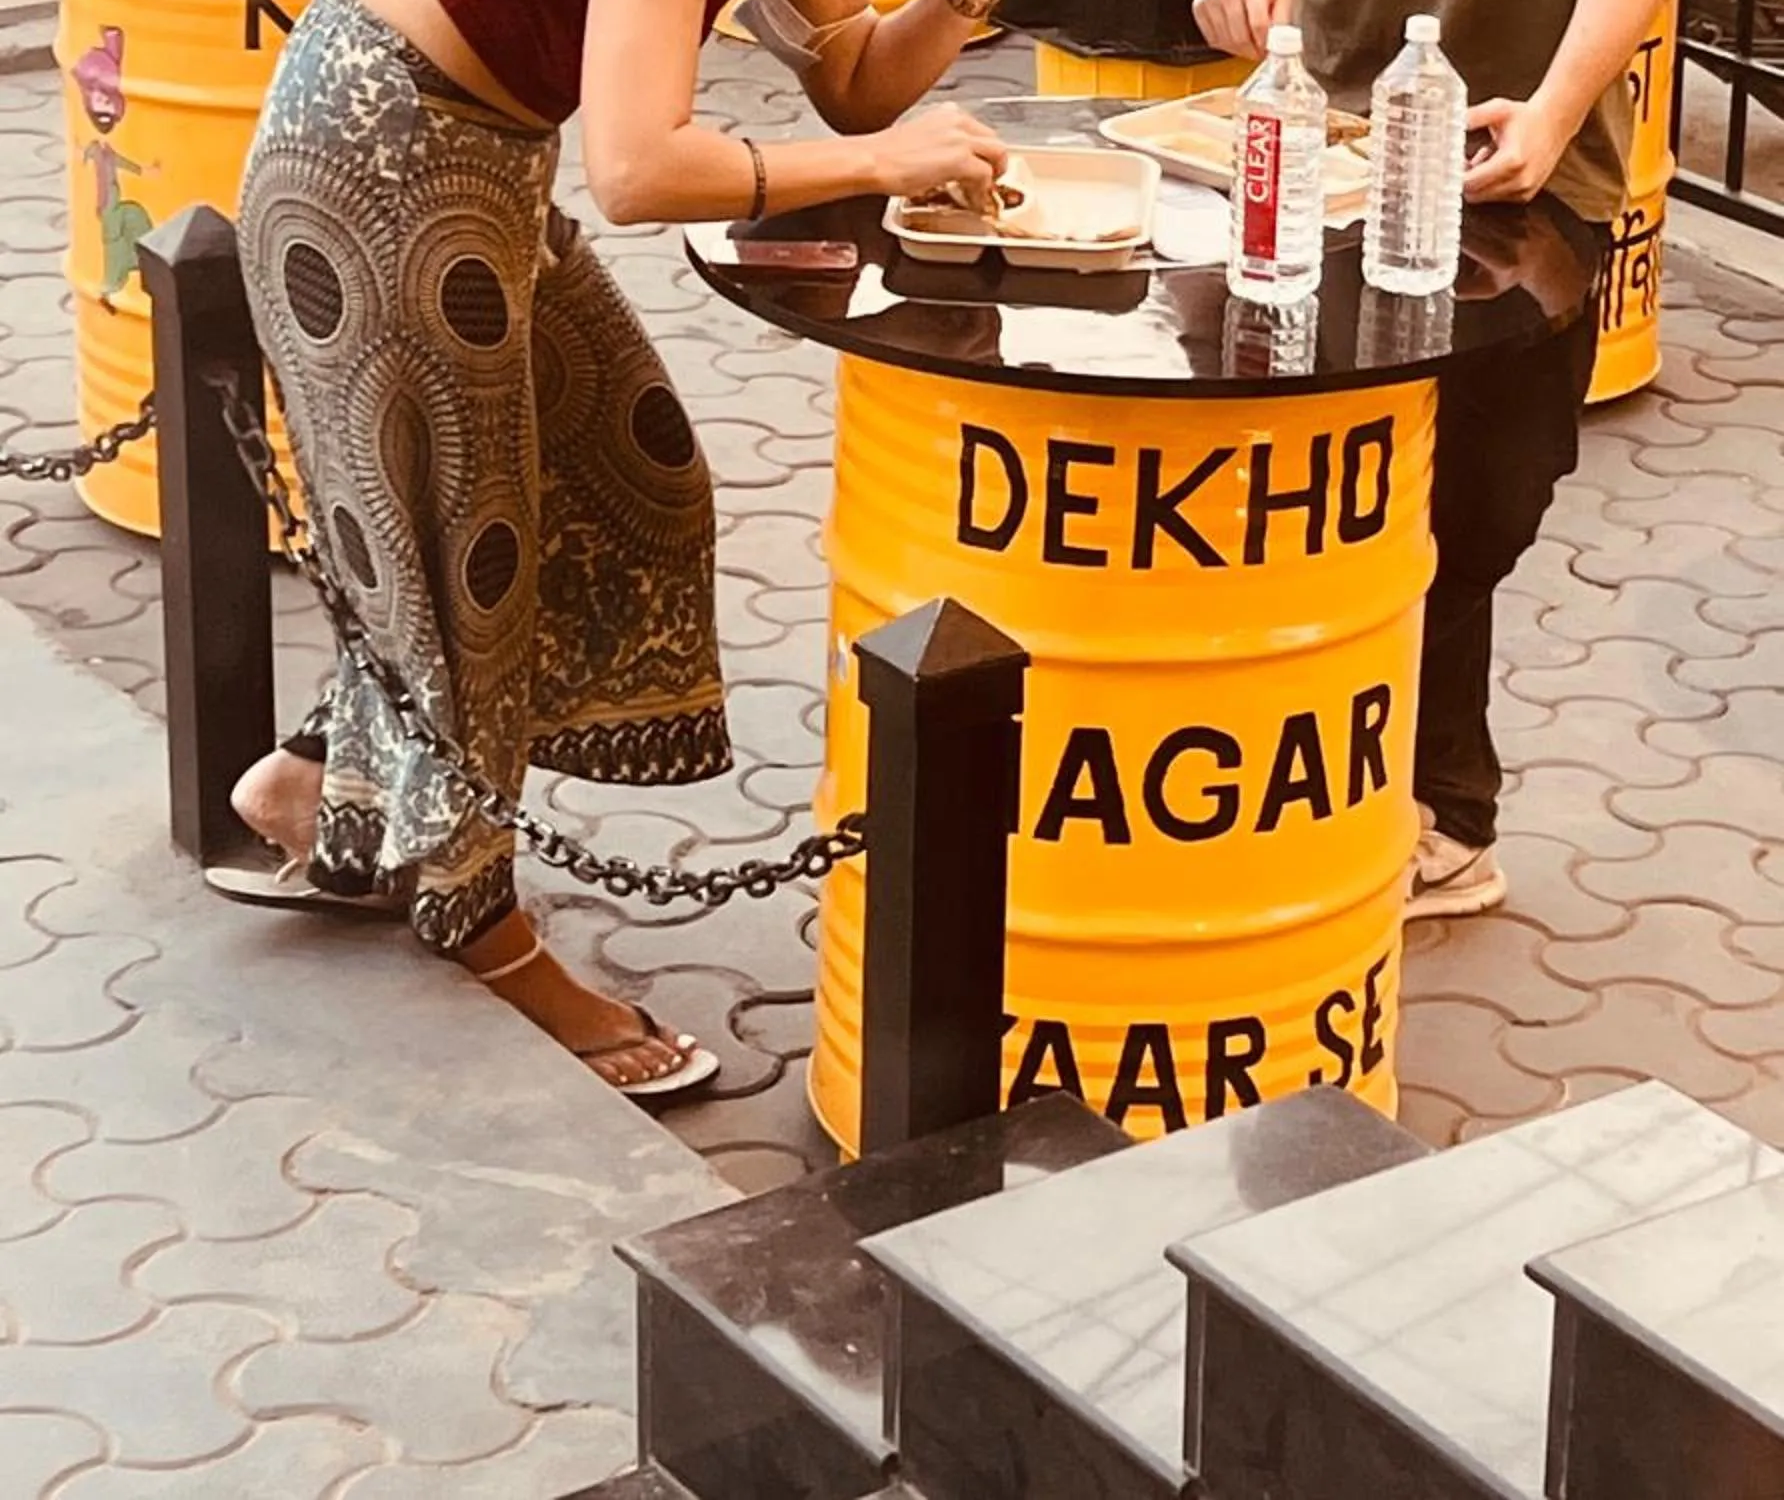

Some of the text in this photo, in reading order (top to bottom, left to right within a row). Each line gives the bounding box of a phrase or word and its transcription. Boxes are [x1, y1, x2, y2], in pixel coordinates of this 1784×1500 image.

[1246, 119, 1271, 203] CLEAR
[957, 414, 1395, 570] DEKHO
[1008, 683, 1392, 845] AGAR
[1000, 950, 1392, 1134] AAR SE
